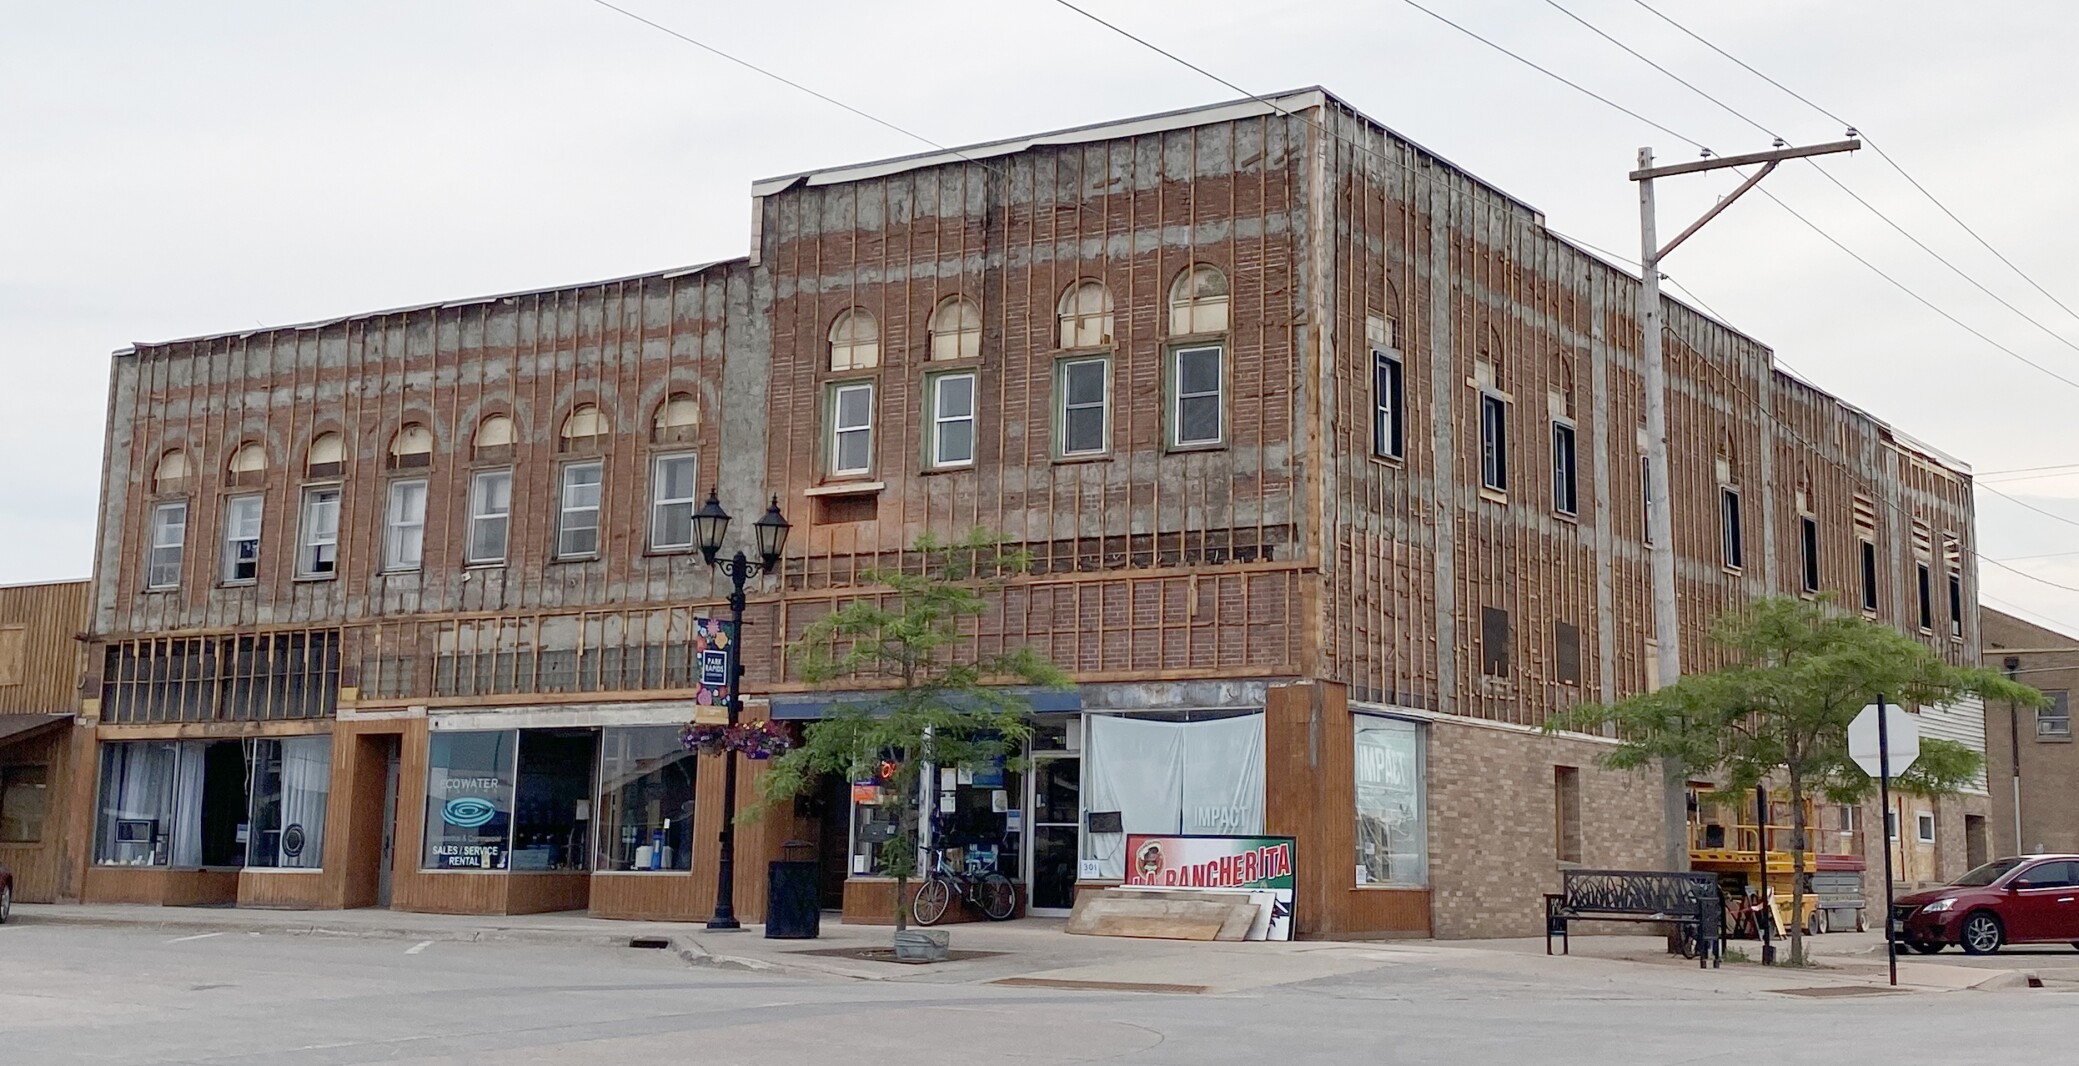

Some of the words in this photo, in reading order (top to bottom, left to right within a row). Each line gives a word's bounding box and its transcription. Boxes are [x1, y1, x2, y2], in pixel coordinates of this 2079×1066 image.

[707, 657, 721, 665] PARK
[705, 665, 723, 673] RAPIDS
[1359, 745, 1406, 784] IMPACT
[440, 778, 498, 789] ECOWATER
[1194, 805, 1249, 828] IMPACT
[433, 845, 458, 855] SALES
[464, 846, 499, 856] SERVICE
[449, 856, 480, 866] RENTAL
[1165, 843, 1292, 888] RANCHERITA
